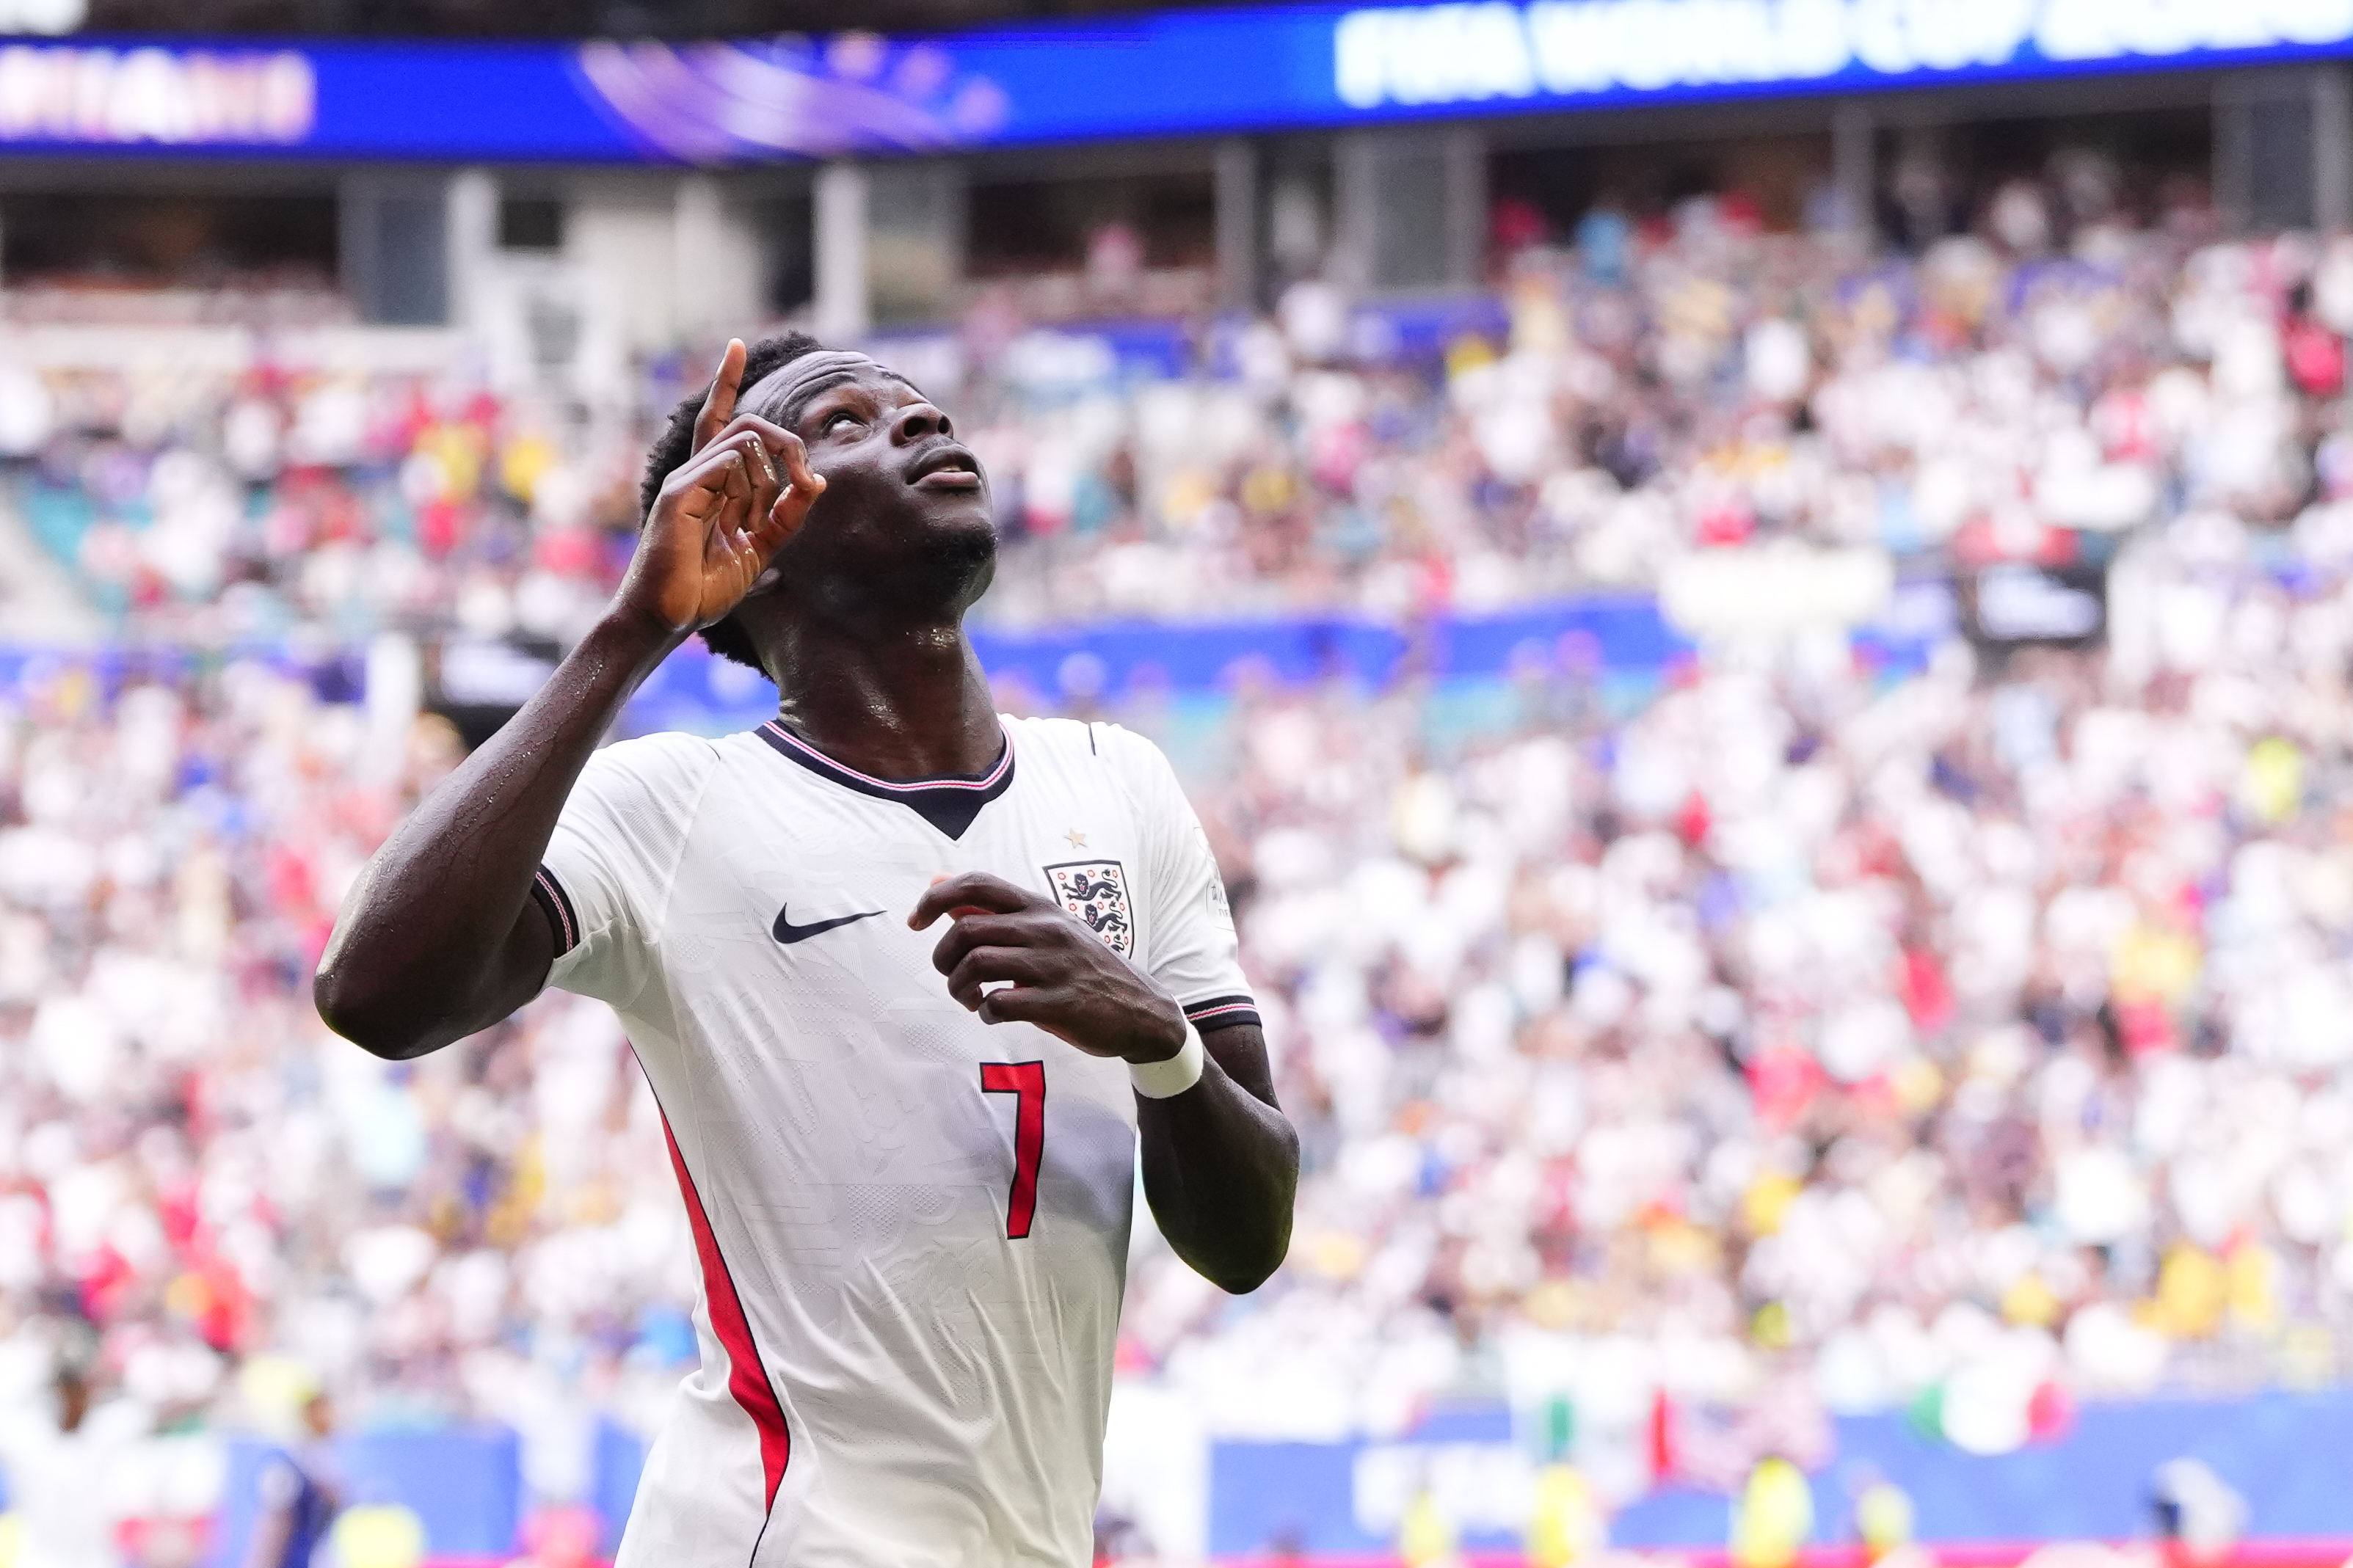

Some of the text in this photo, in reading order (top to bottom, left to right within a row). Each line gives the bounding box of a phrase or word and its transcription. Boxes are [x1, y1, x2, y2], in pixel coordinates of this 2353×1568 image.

[1337, 3, 1535, 107] FIFA
[1538, 0, 1851, 93] WORLD
[979, 1060, 1046, 1239] 7
